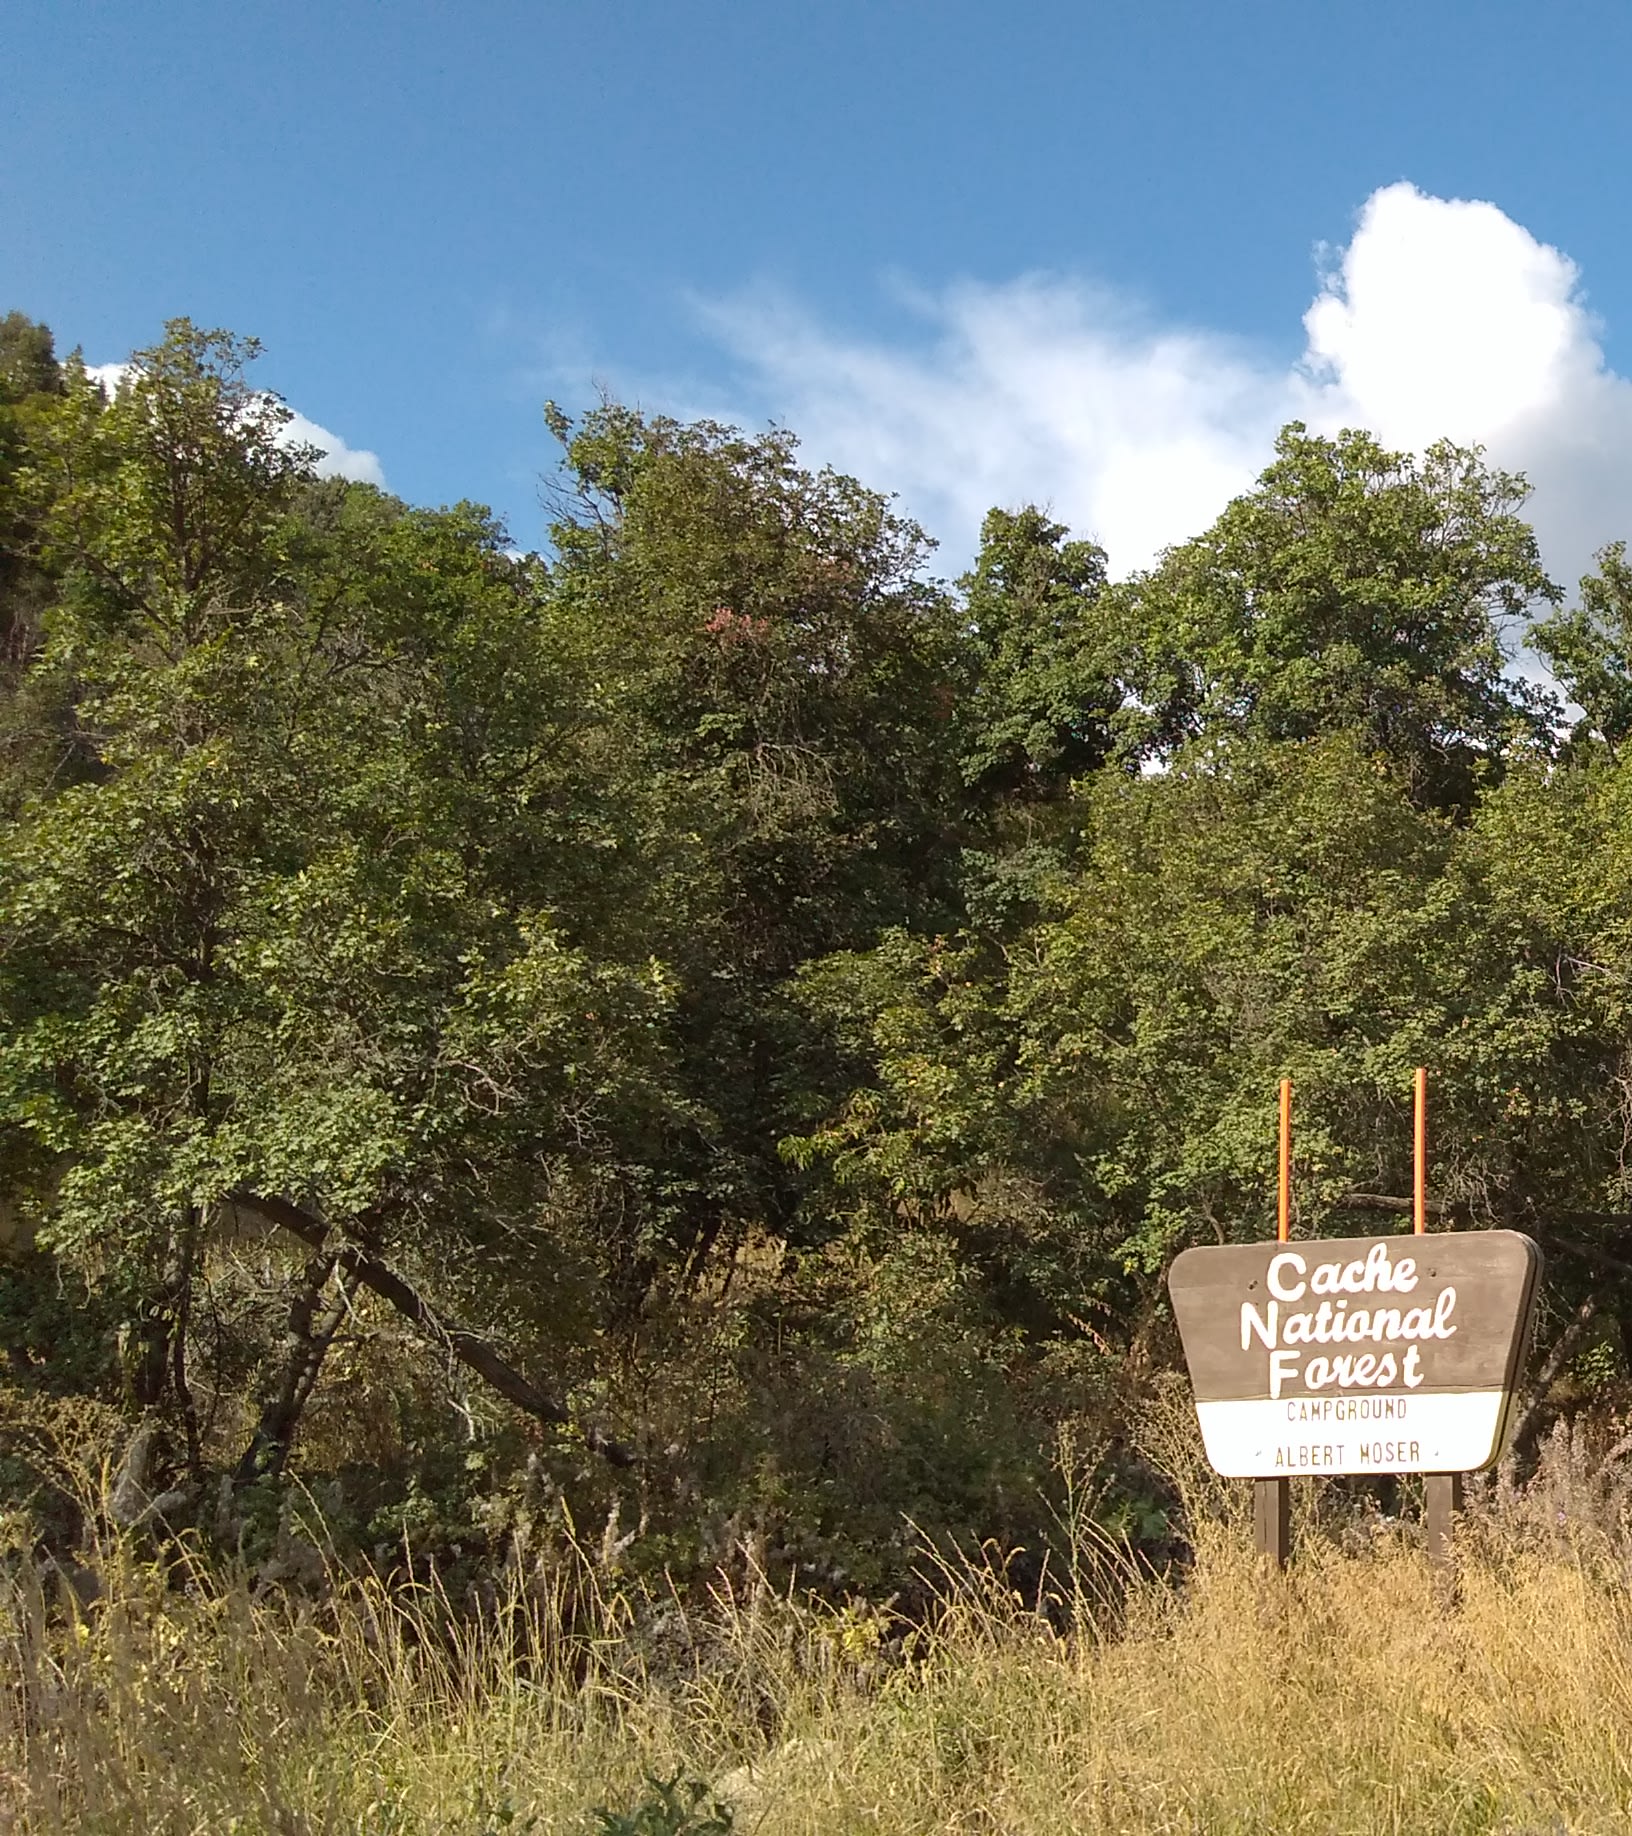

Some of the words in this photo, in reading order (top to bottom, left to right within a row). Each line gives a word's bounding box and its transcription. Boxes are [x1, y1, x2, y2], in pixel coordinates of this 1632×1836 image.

[1267, 1242, 1419, 1302] Cache
[1241, 1286, 1457, 1351] National
[1269, 1344, 1424, 1399] Forest
[1287, 1398, 1407, 1421] CAMPGROUND
[1275, 1445, 1345, 1468] ALBERT
[1360, 1441, 1420, 1464] MOSER
